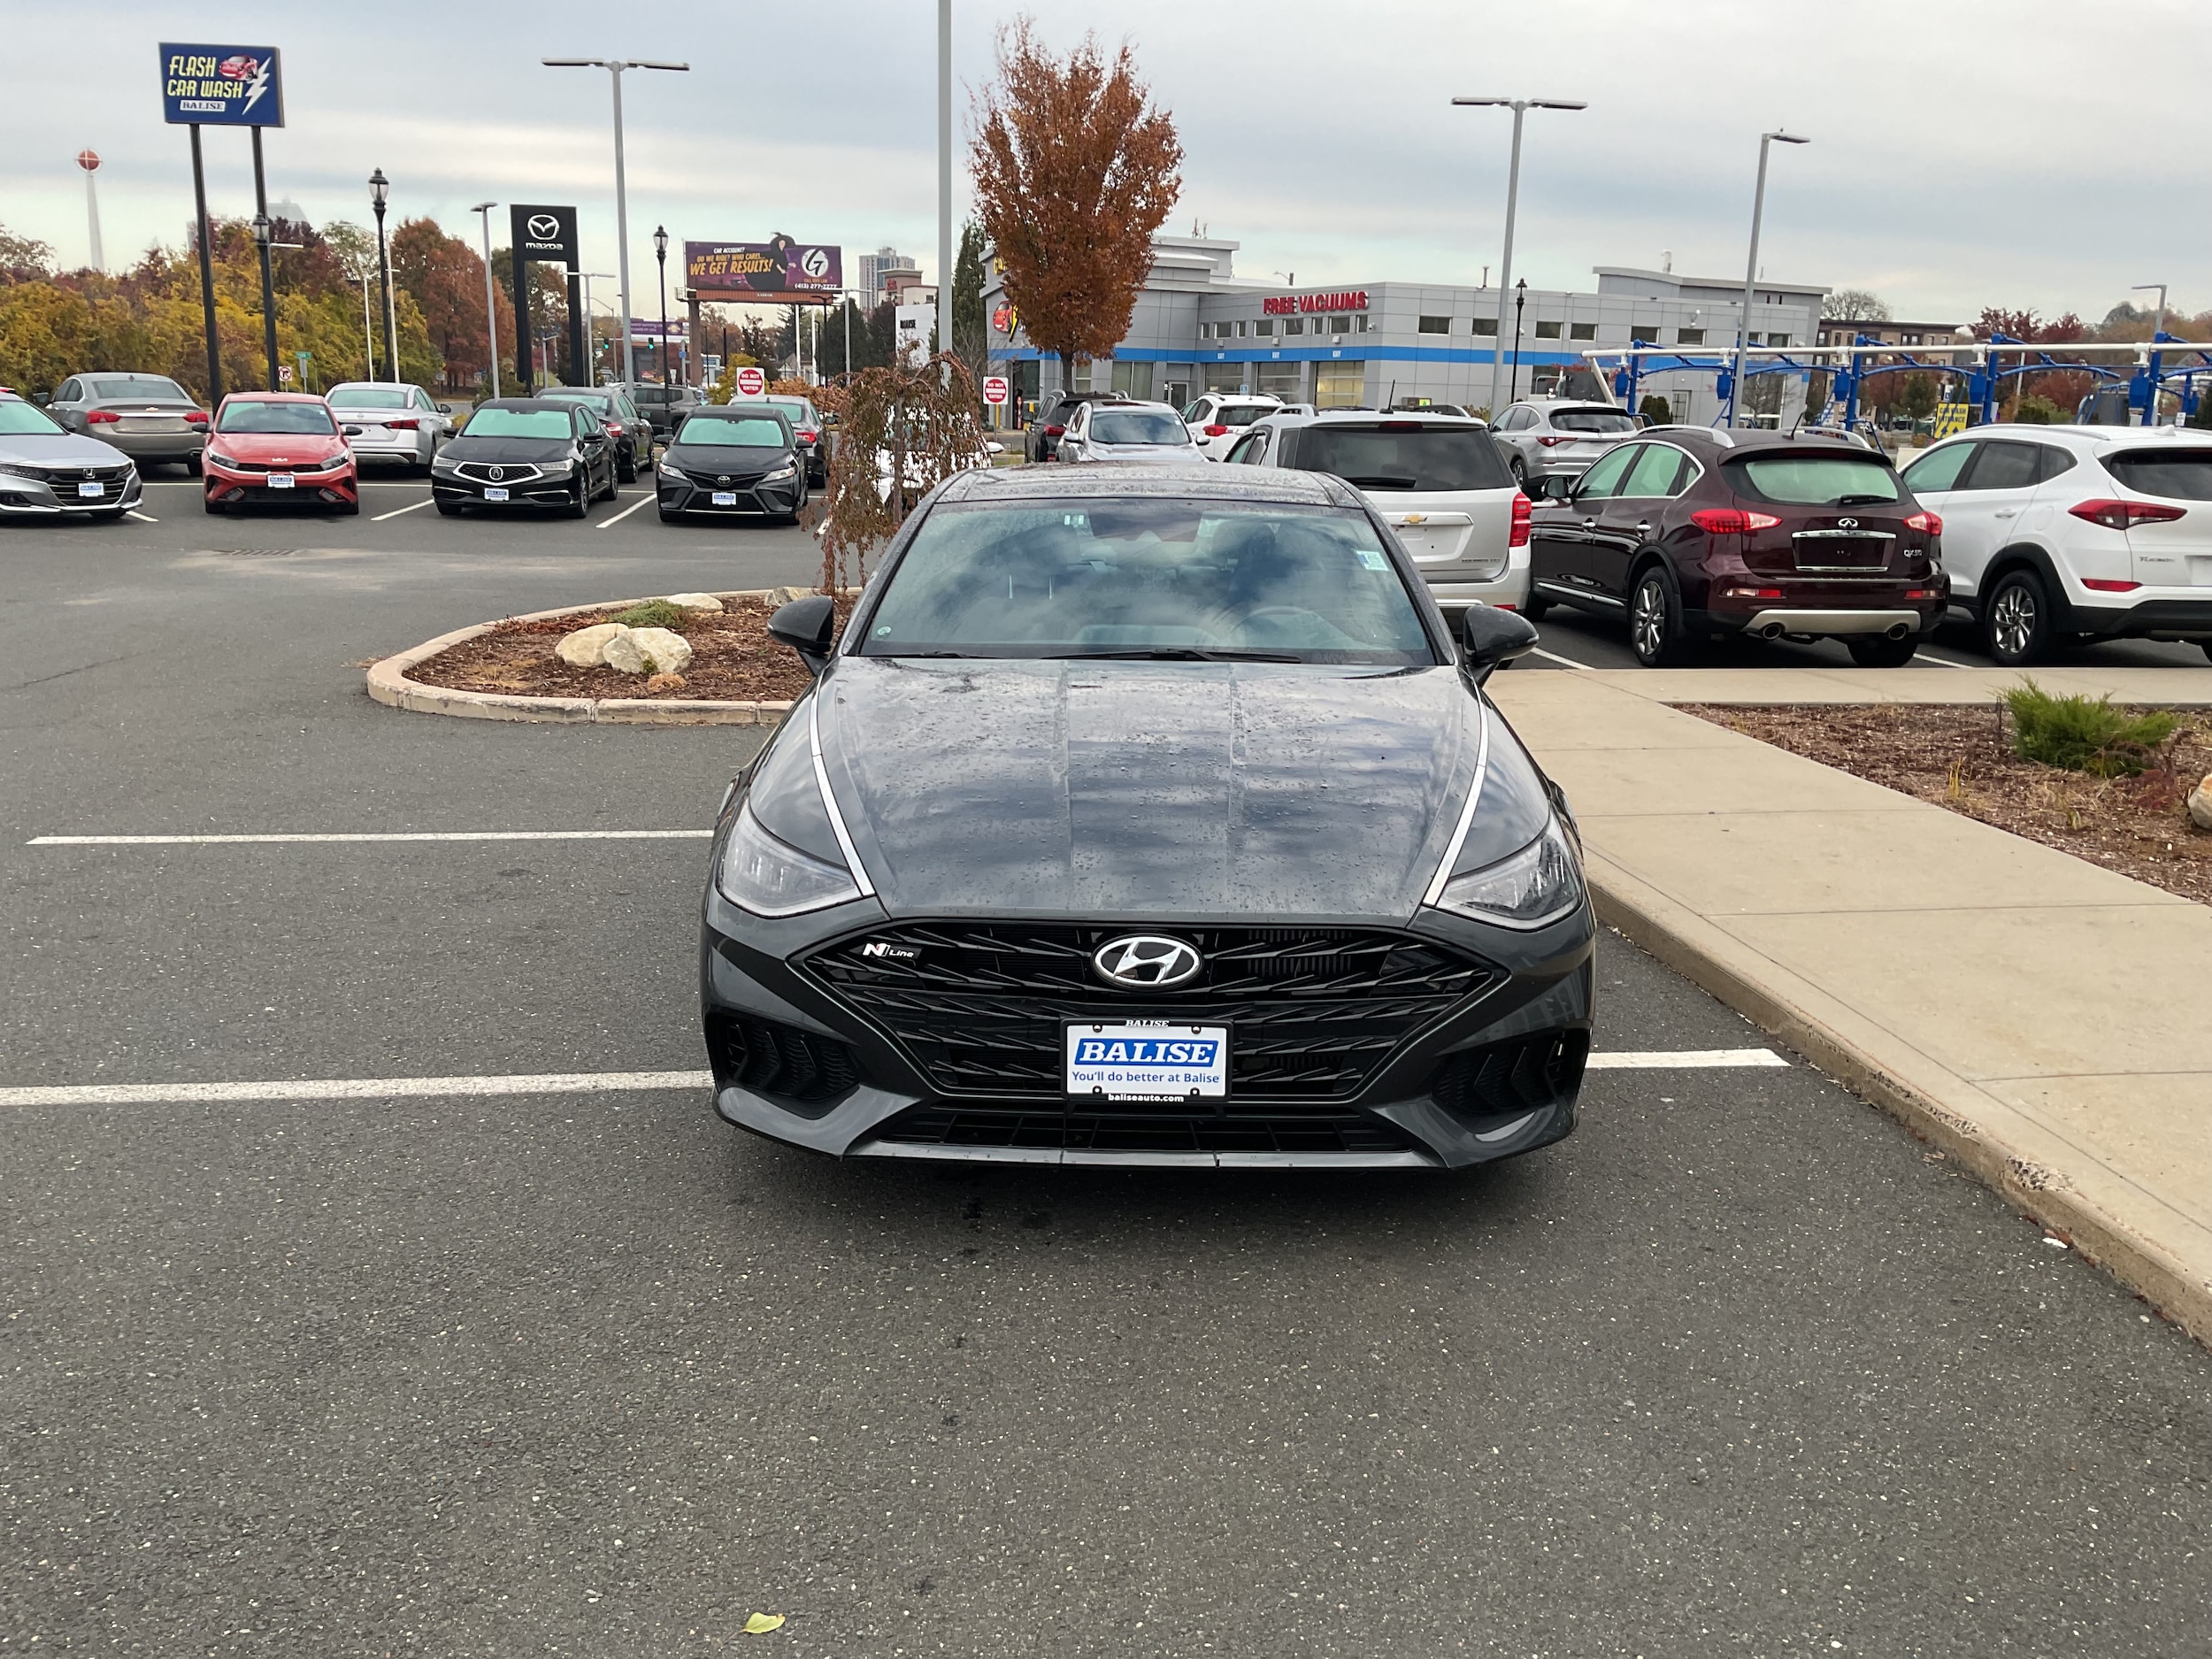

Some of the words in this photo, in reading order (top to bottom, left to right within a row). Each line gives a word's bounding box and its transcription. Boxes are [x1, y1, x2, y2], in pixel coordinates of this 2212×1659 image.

[169, 56, 217, 77] FLASH
[167, 79, 197, 96] CAR
[200, 81, 243, 98] WASH
[182, 101, 224, 111] BALISE
[526, 242, 564, 250] mazda
[690, 262, 706, 275] WE
[709, 261, 728, 275] GET
[730, 258, 774, 273] RESULTS!
[1263, 296, 1297, 314] FREE
[1299, 290, 1369, 312] VACUUMS
[863, 942, 891, 957] N
[889, 949, 914, 958] Line
[1079, 1041, 1214, 1064] BALISE
[1072, 1071, 1104, 1081] You'll
[1108, 1071, 1123, 1081] do
[1126, 1071, 1164, 1082] better
[1168, 1073, 1180, 1082] at
[1184, 1073, 1219, 1083] Balise
[1108, 1093, 1184, 1102] baliseauto.com
